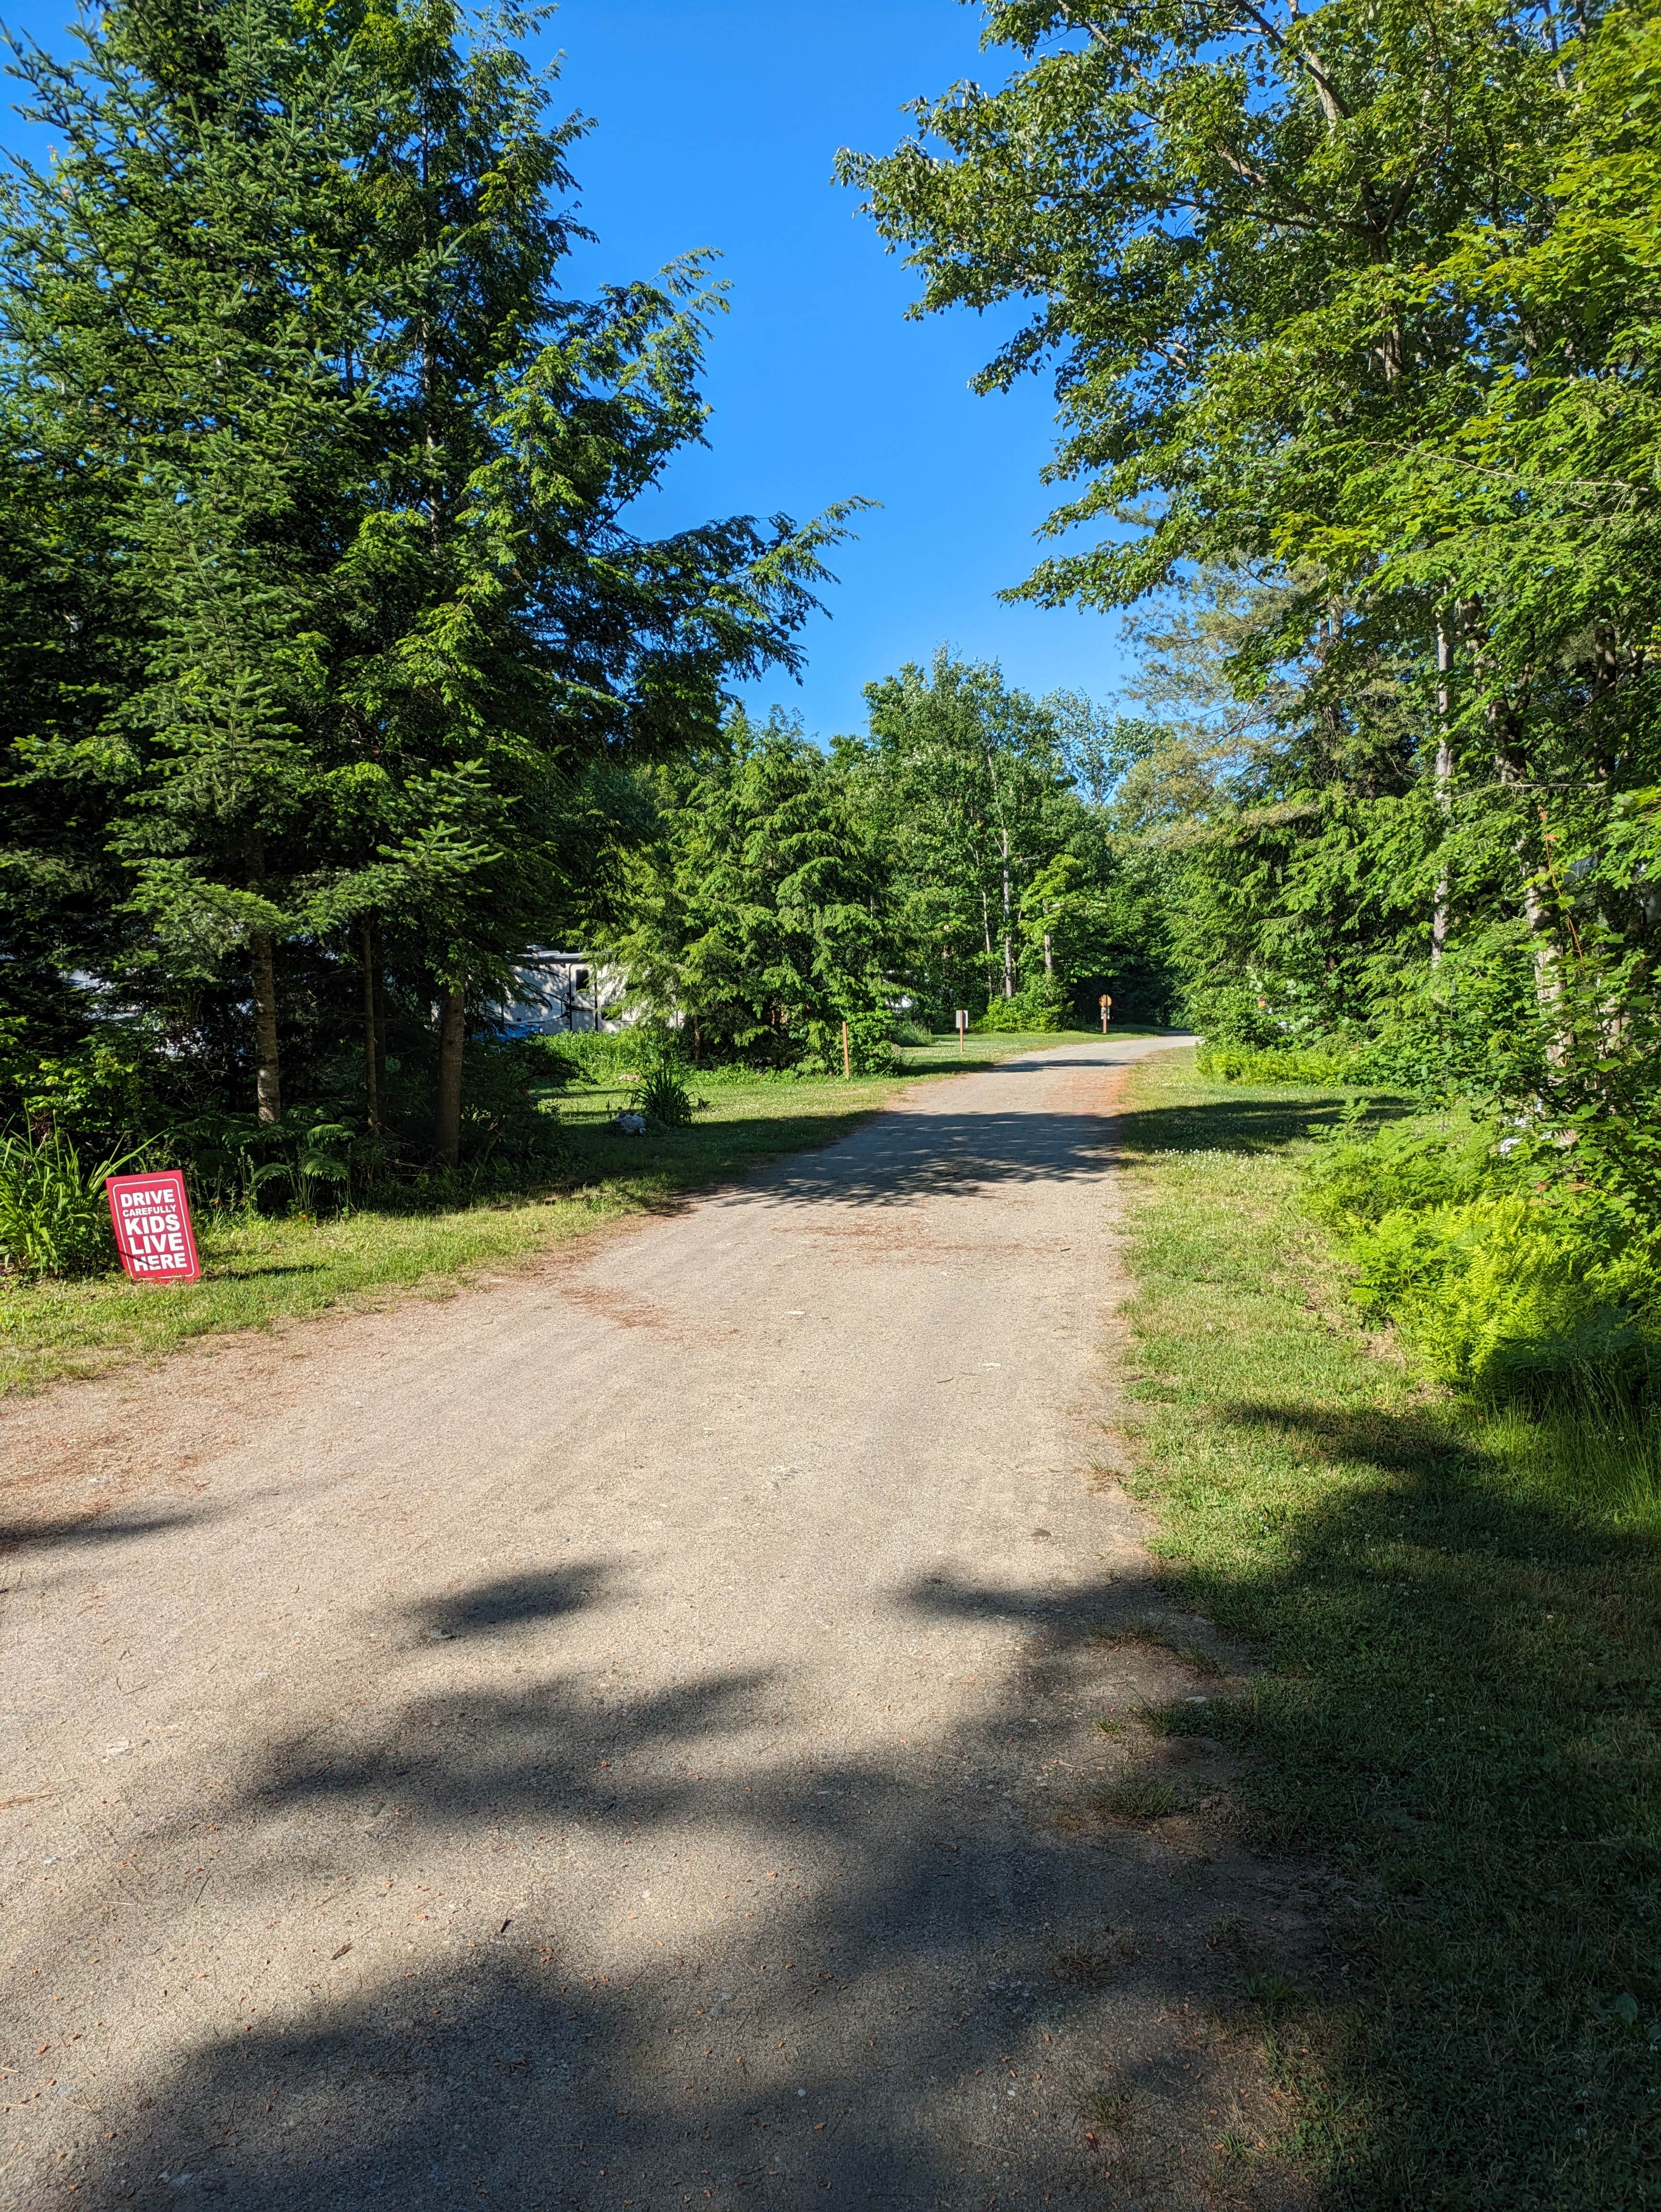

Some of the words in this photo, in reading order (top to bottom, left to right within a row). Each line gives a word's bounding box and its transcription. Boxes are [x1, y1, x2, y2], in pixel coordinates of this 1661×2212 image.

[120, 1189, 175, 1207] DRIVE
[122, 1205, 176, 1217] CAREFULLY
[124, 1214, 180, 1236] KIDS
[128, 1232, 184, 1255] LIVE
[133, 1252, 187, 1272] HERE
